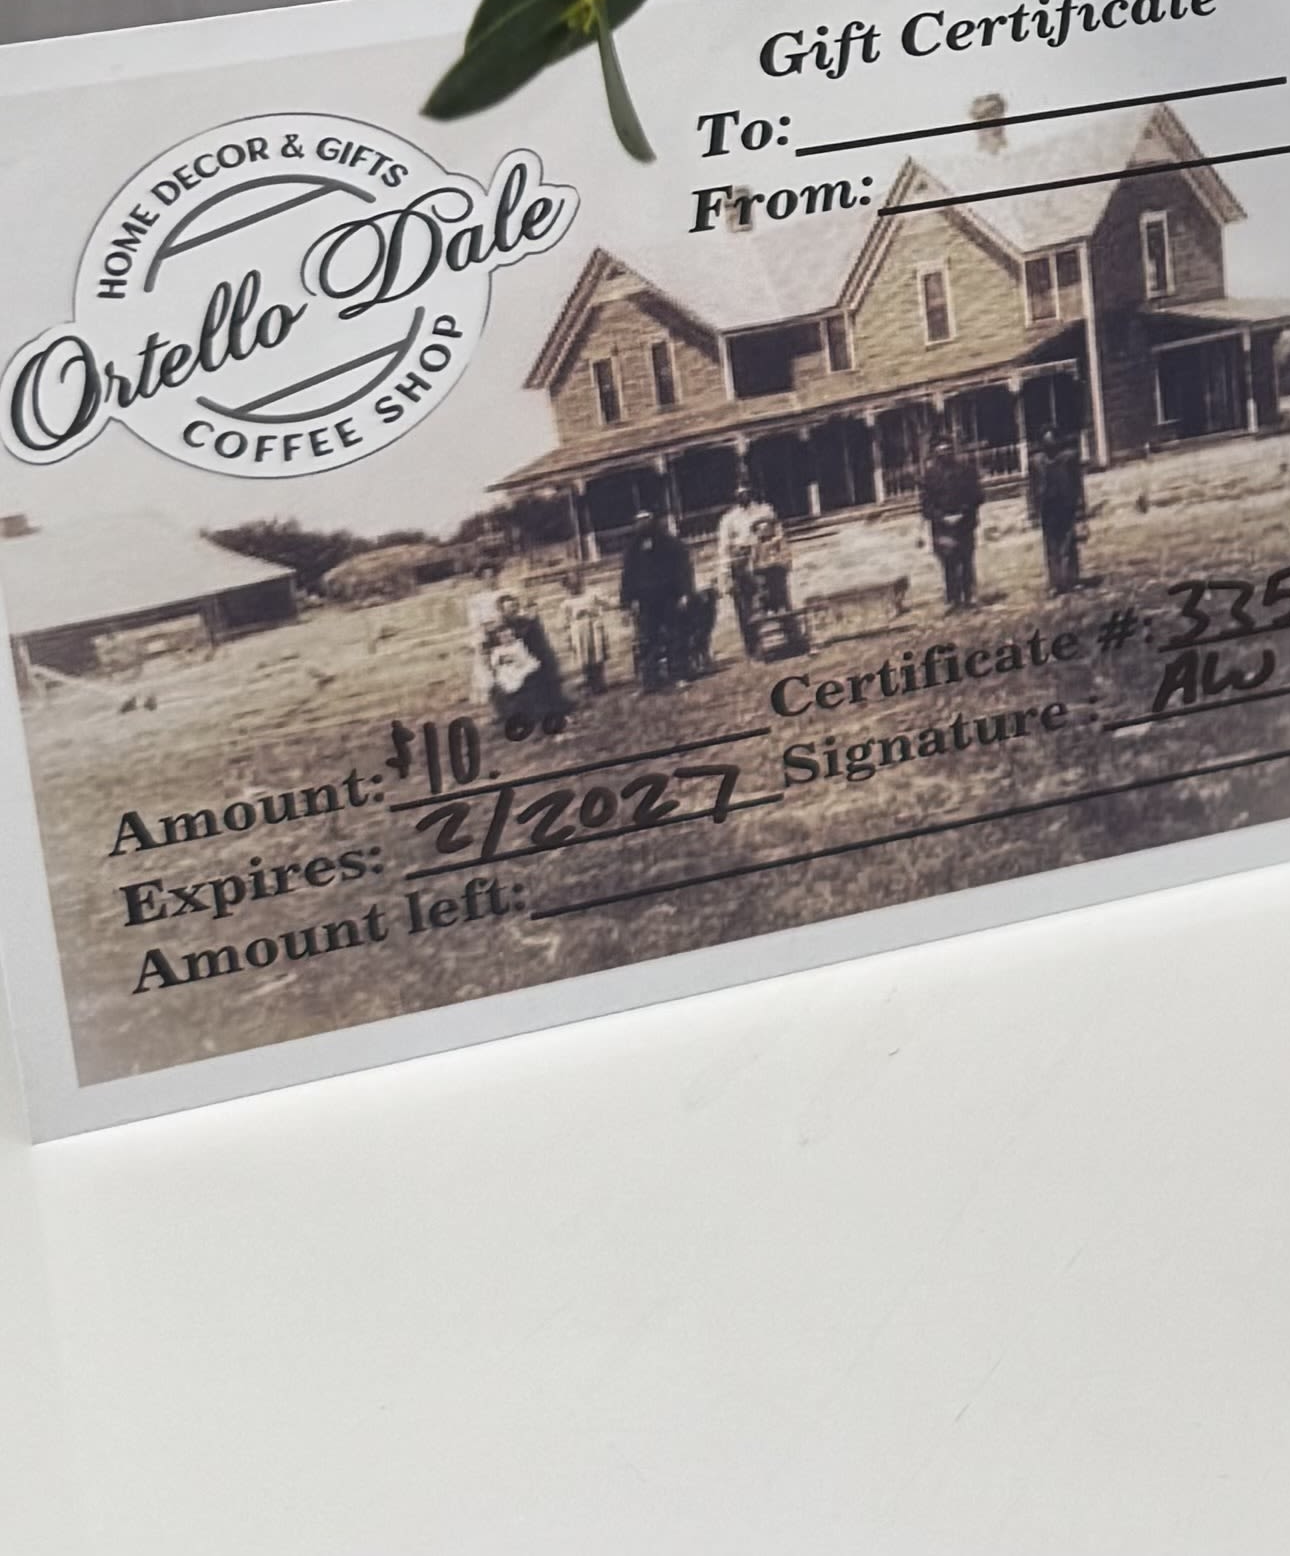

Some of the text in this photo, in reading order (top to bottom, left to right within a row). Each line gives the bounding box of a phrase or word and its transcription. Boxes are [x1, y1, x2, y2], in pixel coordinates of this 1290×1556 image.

[759, 20, 882, 80] Gift
[696, 111, 792, 158] To:
[98, 133, 409, 298] HOME DECOR & GIFTS
[688, 176, 873, 234] From:
[10, 163, 565, 451] Ortello Dale
[183, 314, 464, 462] COFFEE SHOP
[770, 608, 1155, 719] Certificate #:
[782, 697, 1069, 788] Signature
[108, 768, 385, 857] Amount:
[415, 764, 741, 859] 2/2027
[121, 846, 383, 927] Expires:
[133, 878, 528, 994] Amount left:
